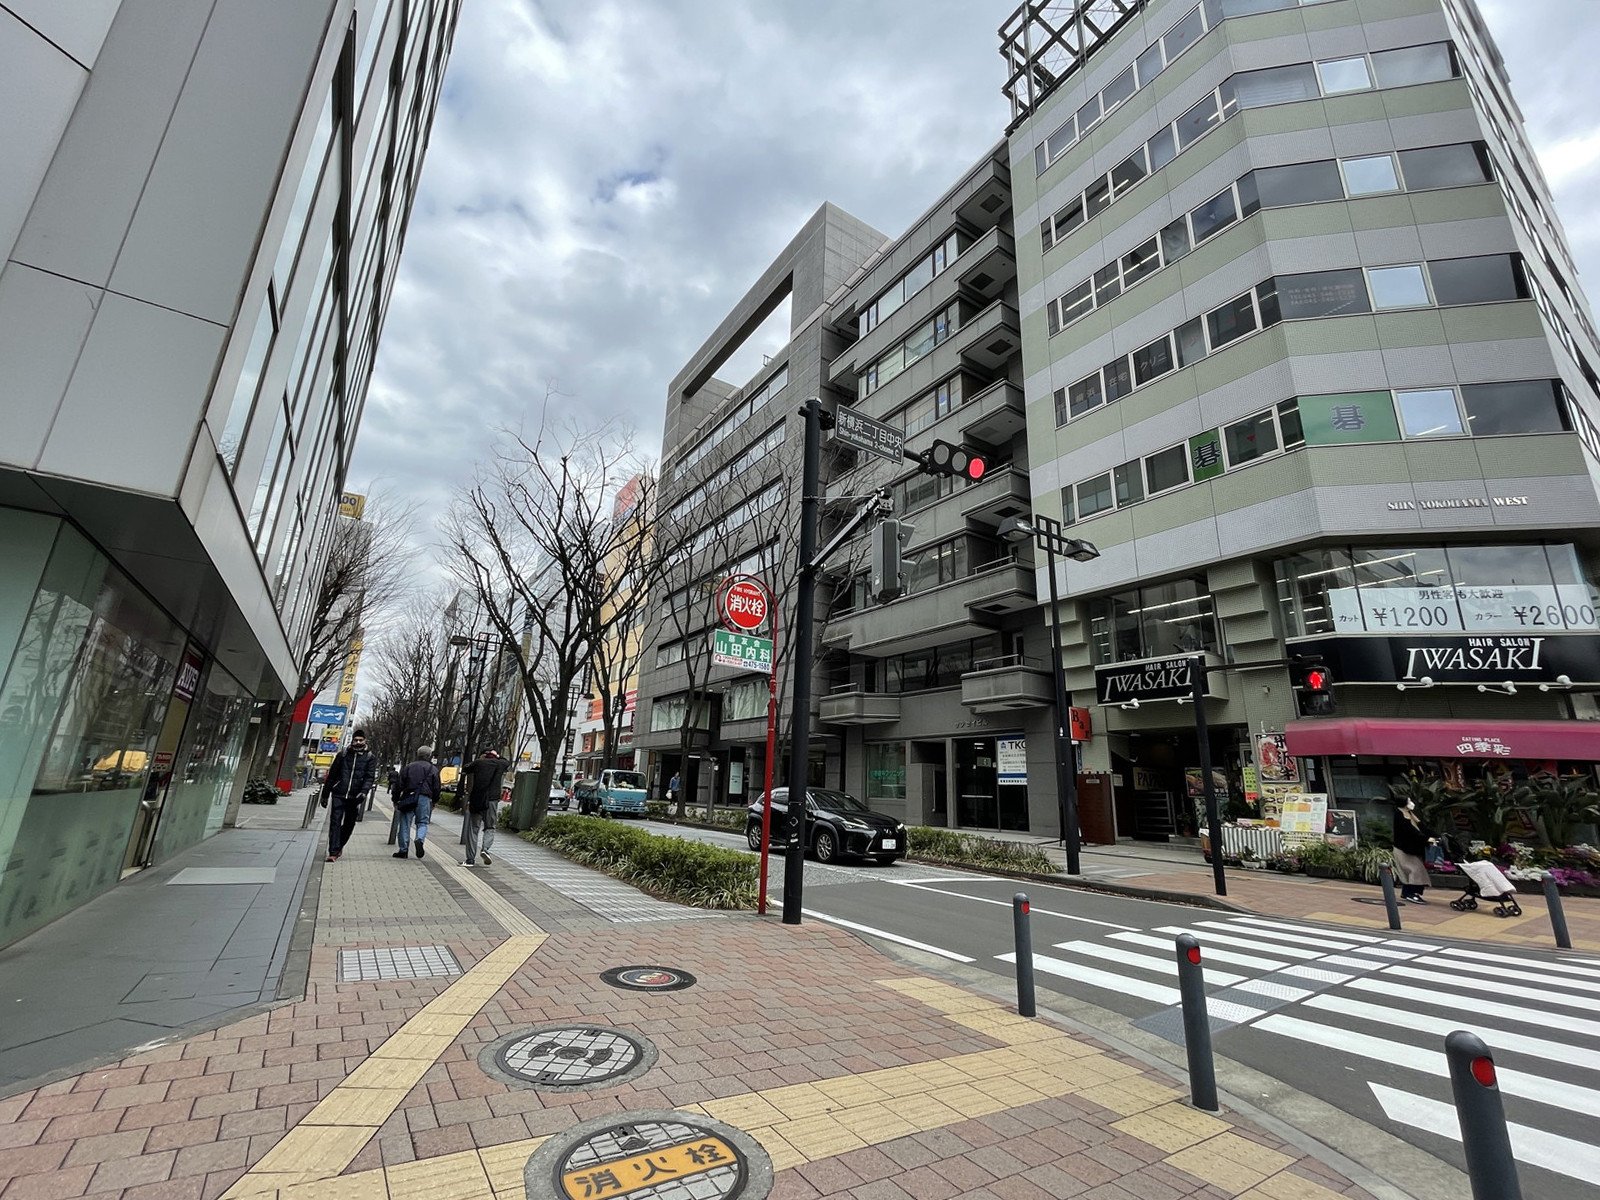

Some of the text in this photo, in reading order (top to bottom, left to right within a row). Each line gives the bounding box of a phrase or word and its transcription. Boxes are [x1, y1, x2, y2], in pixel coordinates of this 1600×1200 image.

[1330, 404, 1365, 431] 碁
[838, 411, 902, 449] 新横浜二丁目中央
[1193, 439, 1222, 469] 碁
[1387, 496, 1529, 511] SHIN YOKOHAMA WEST
[729, 593, 764, 617] 消火栓
[1418, 588, 1504, 600] 男性客も大歓迎
[1338, 604, 1596, 627] カット ¥1200 カラー ¥2600
[716, 640, 771, 662] 山田内科
[1468, 638, 1531, 647] HAIR SALON
[1145, 659, 1187, 672] HAIR SALON
[1402, 638, 1545, 680] IWASAKI
[1102, 659, 1194, 702] IWASAKI
[1071, 709, 1091, 739] Bar
[1456, 741, 1511, 756] 四季彩
[574, 1142, 727, 1197] 消火栓
